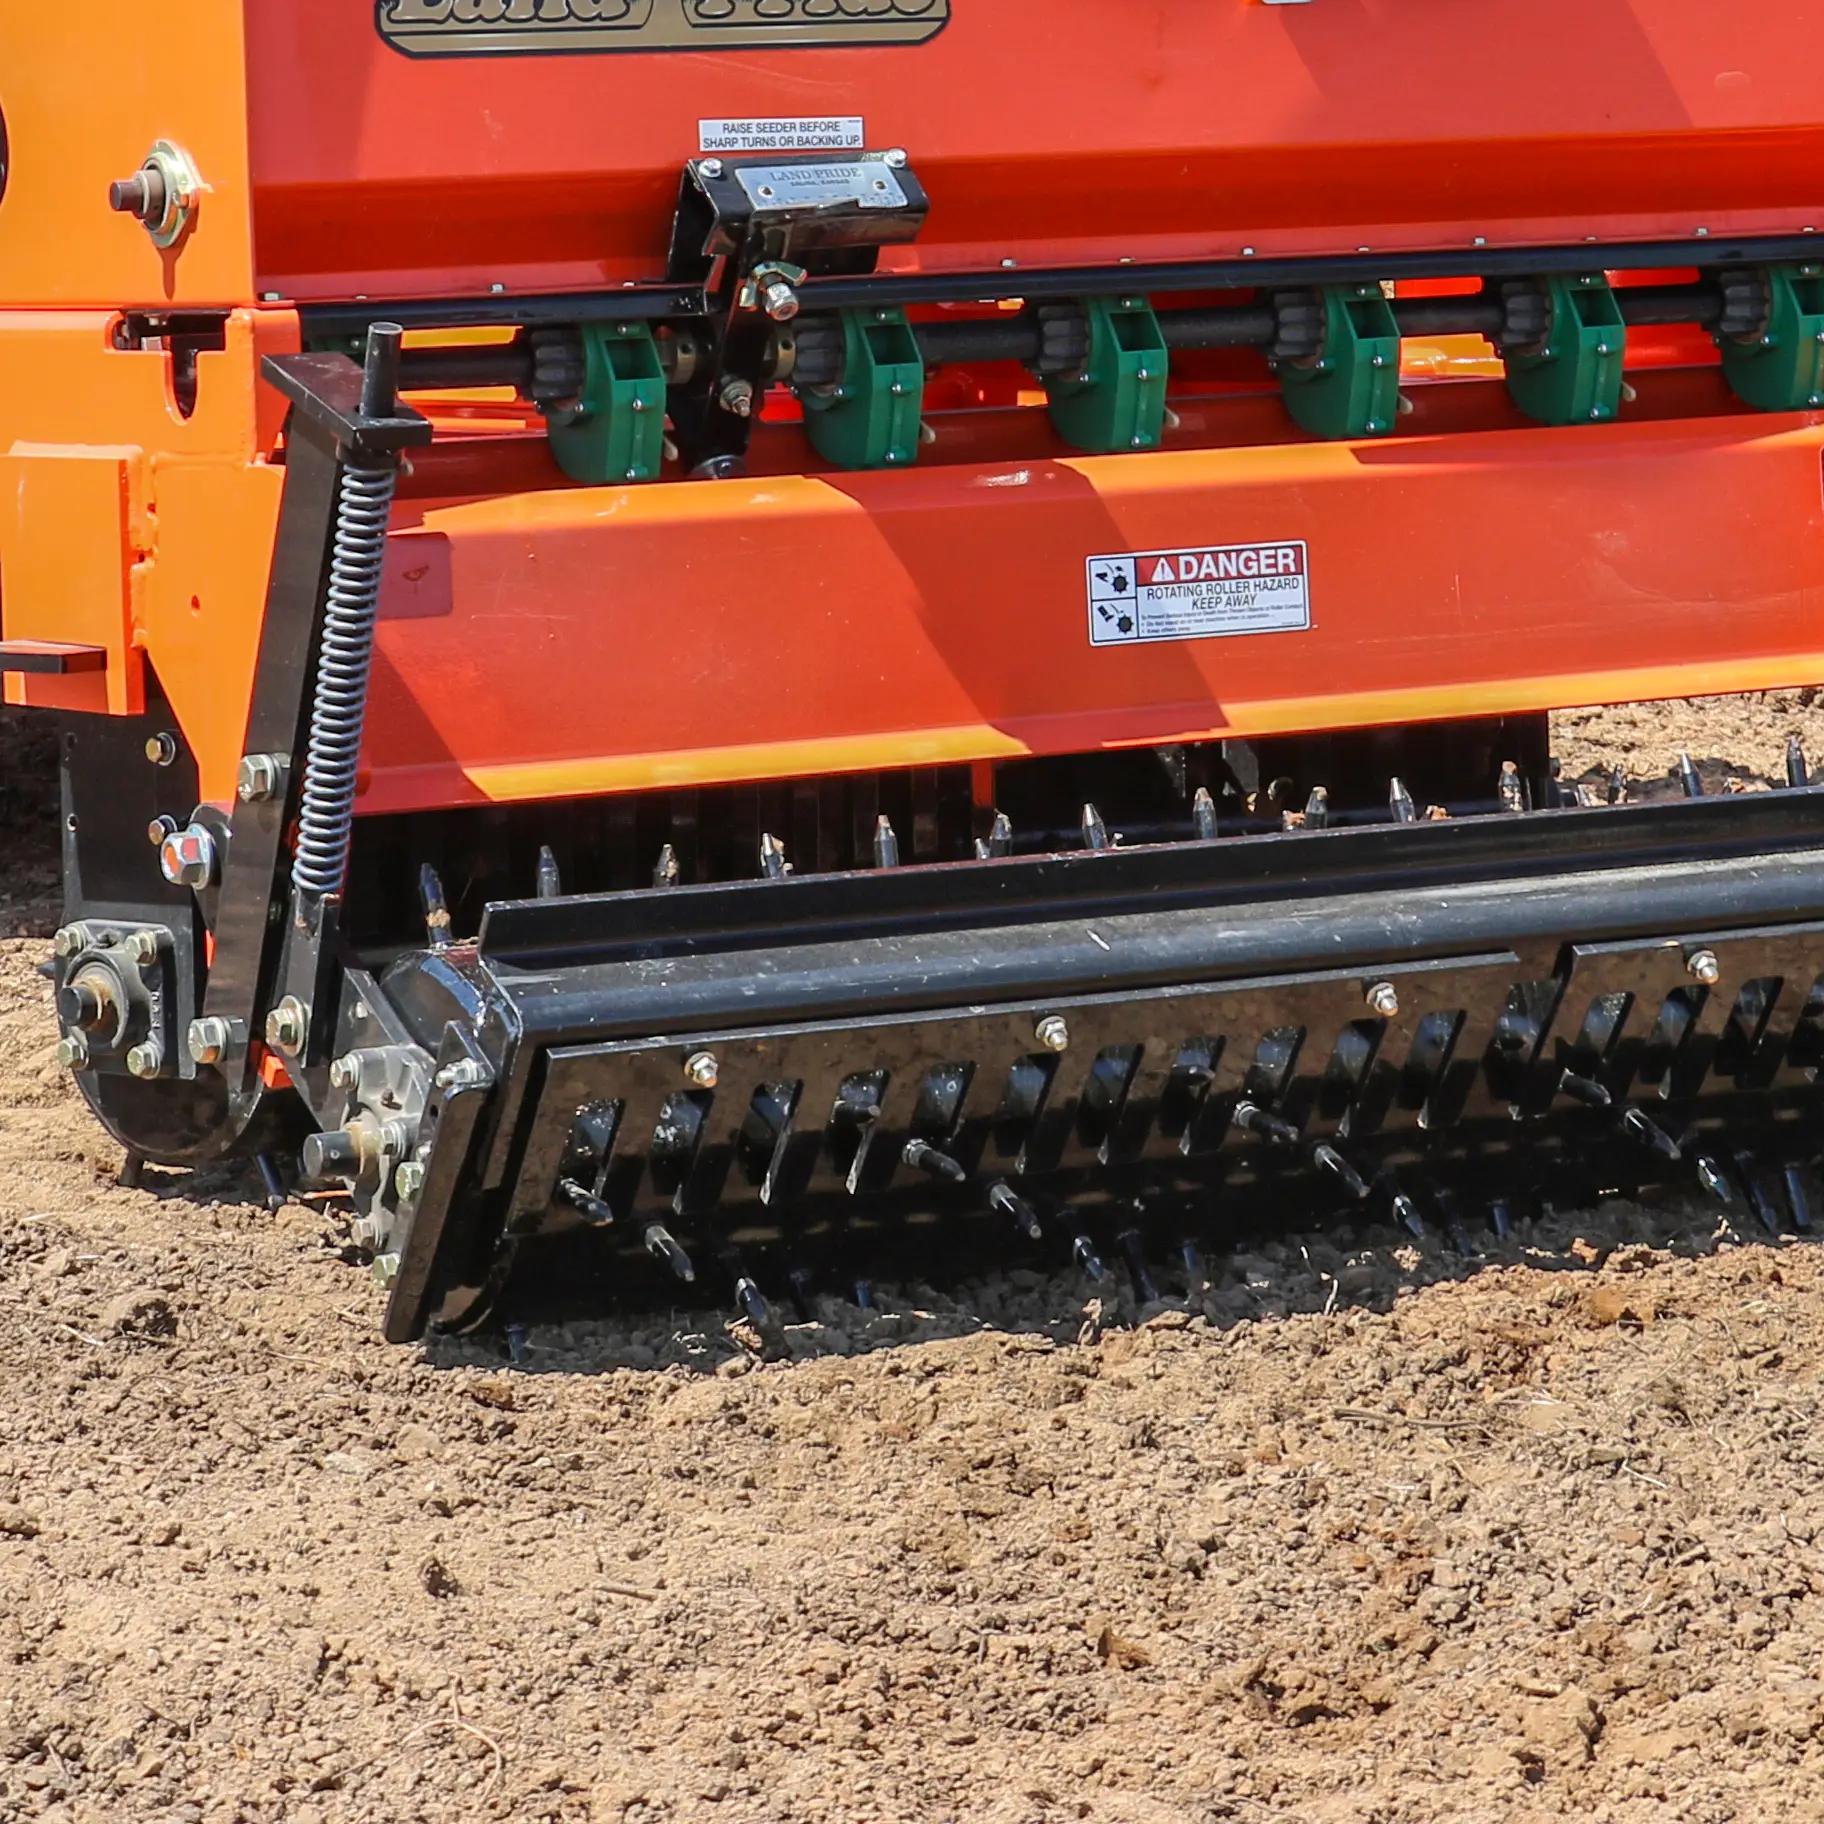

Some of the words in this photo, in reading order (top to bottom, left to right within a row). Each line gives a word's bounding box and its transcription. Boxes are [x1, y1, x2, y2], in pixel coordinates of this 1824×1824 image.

[723, 123, 753, 134] RAISE
[756, 122, 797, 133] SEEDER
[799, 121, 841, 132] BEFORE
[703, 137, 739, 148] SHARP
[741, 136, 777, 147] TURNS
[779, 136, 795, 146] OR
[797, 135, 843, 146] BACKING
[846, 135, 862, 145] UP.
[770, 169, 812, 181] LAND
[815, 167, 862, 178] PRIDE
[1178, 547, 1296, 580] DANGER
[1147, 583, 1203, 600] ROTATING
[1206, 580, 1251, 596] ROLLER
[1253, 577, 1300, 592] HAZARD
[1192, 596, 1223, 610] KEEP
[1225, 593, 1258, 608] AWAY
